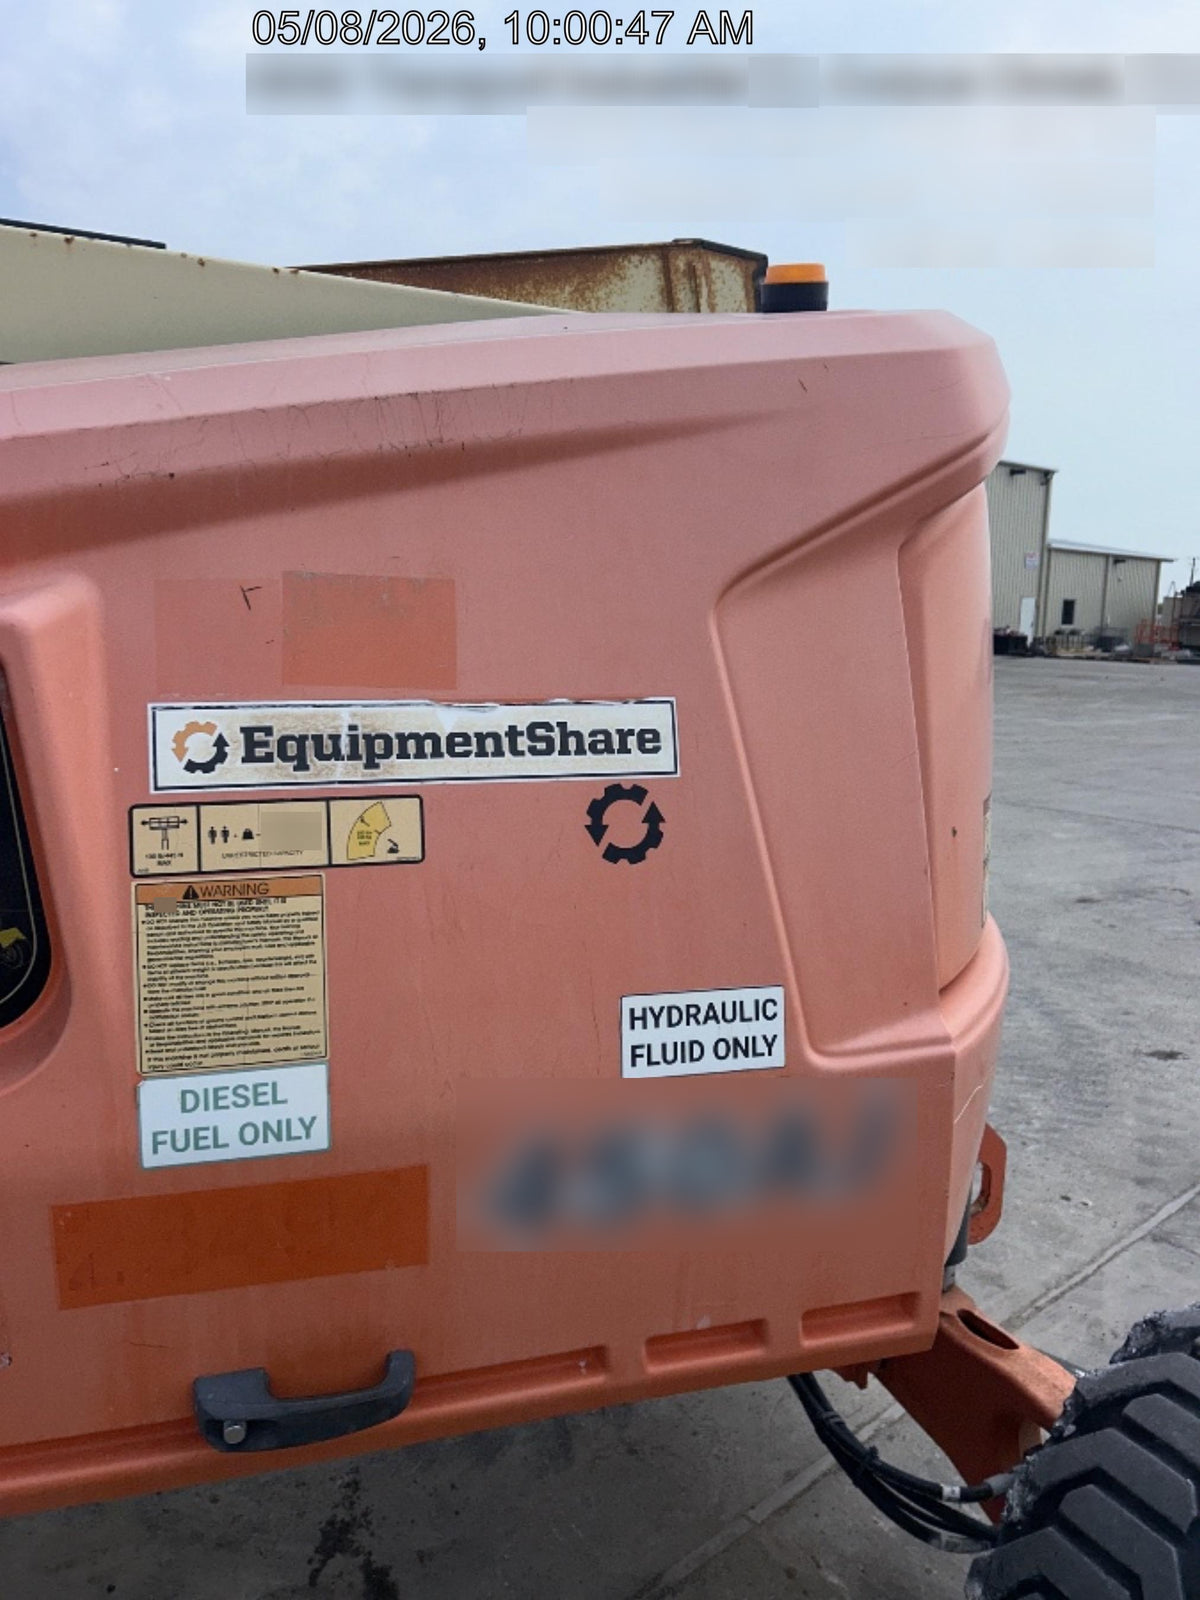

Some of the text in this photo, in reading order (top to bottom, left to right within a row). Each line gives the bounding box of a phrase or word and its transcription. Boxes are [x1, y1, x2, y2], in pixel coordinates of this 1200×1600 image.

[240, 720, 663, 770] EquipmentShare
[200, 883, 270, 897] WARNING
[629, 998, 778, 1030] HYDRAULIC
[630, 1034, 778, 1068] FLUID ONLY
[180, 1081, 288, 1113] DIESEL
[152, 1115, 318, 1155] FUEL ONLY
